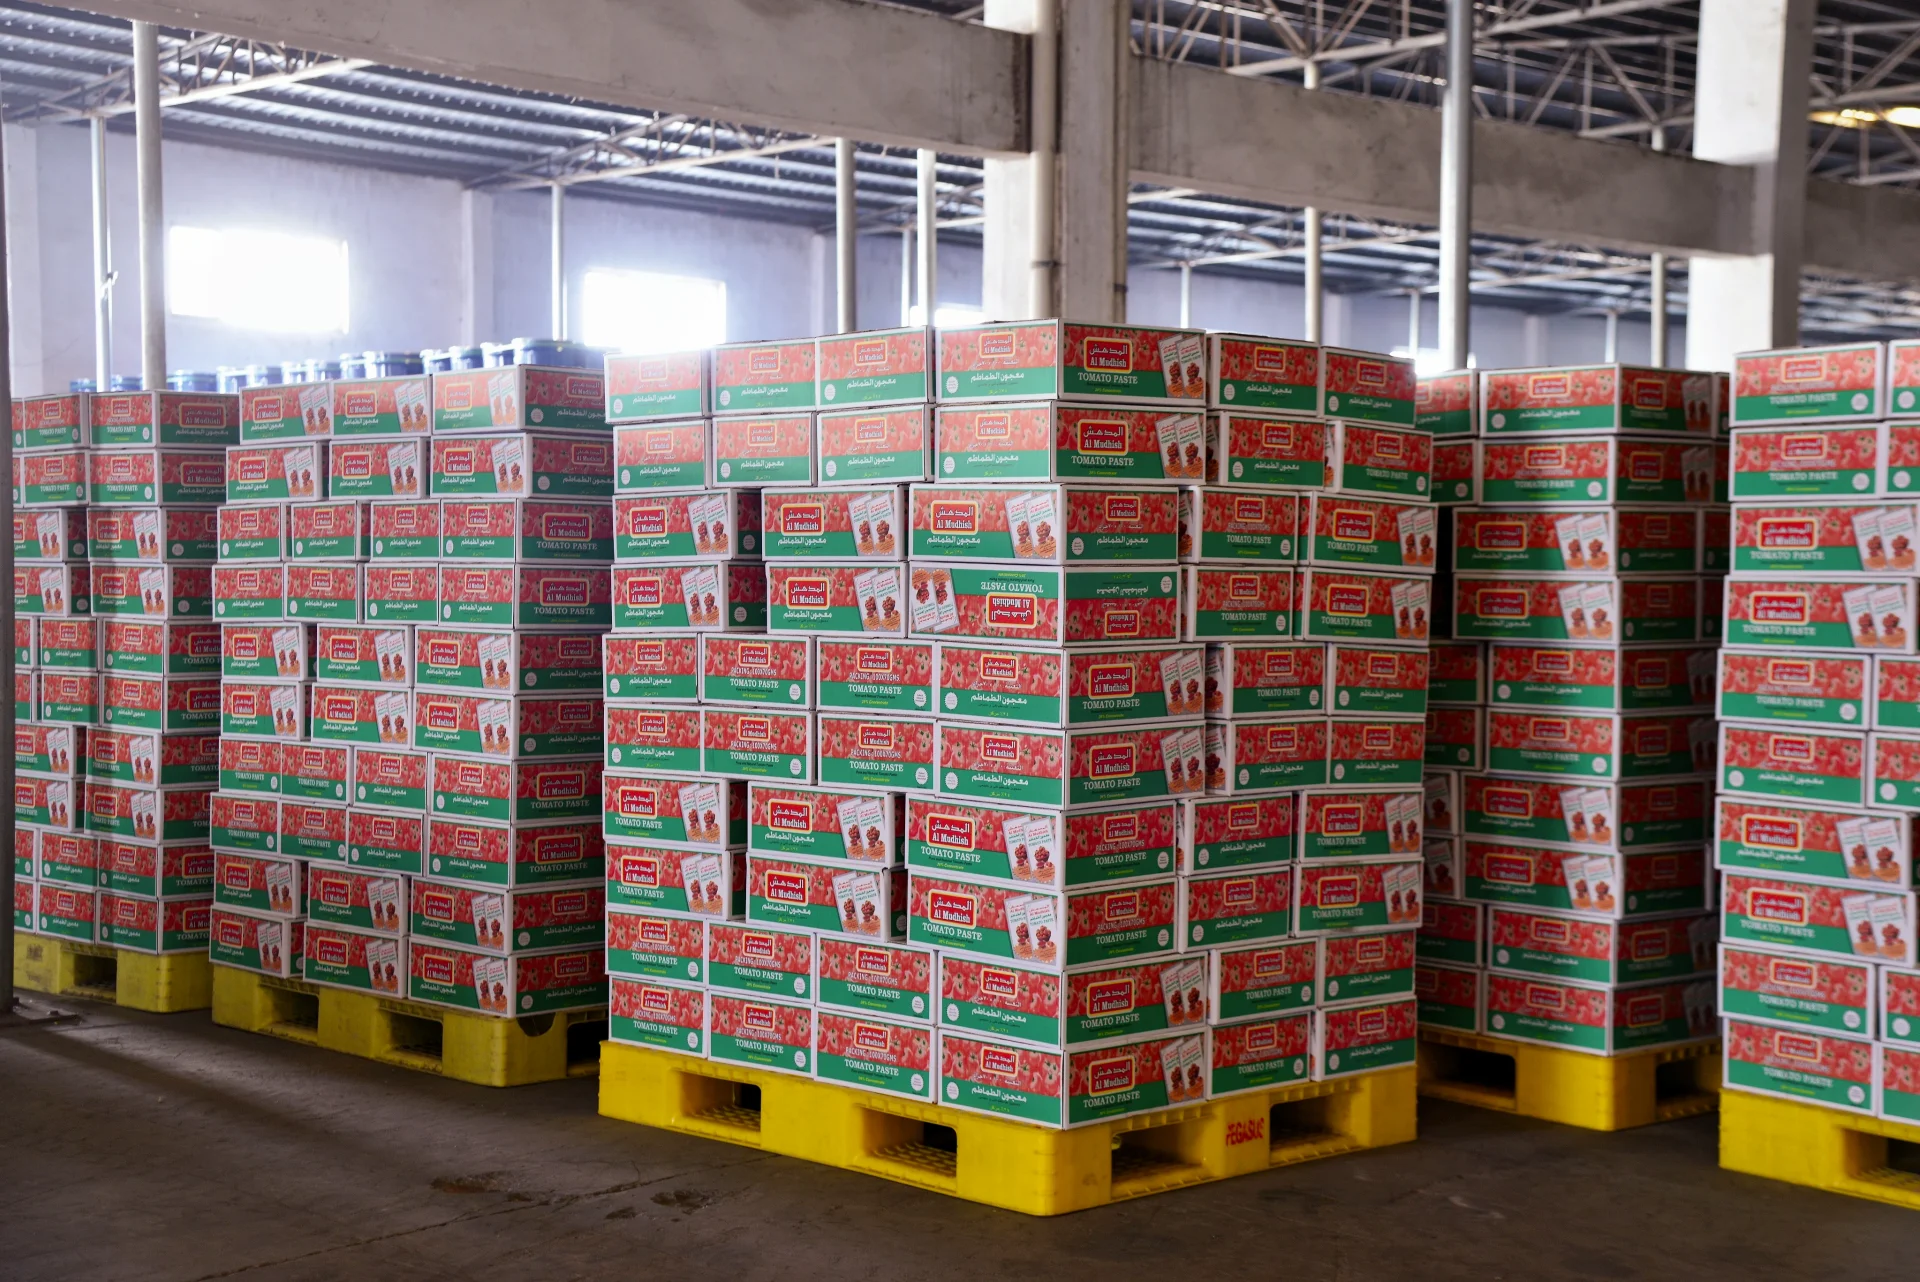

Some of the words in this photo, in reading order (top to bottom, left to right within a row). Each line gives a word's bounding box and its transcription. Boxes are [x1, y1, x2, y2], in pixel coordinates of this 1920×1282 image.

[1090, 357, 1097, 365] Al
[1099, 358, 1126, 367] Mudhish
[1078, 372, 1112, 382] TOMATO
[1114, 375, 1138, 384] PASTE
[1084, 440, 1092, 448] Al
[1094, 440, 1122, 449] Mudhish
[1071, 456, 1106, 464] TOMATO
[1109, 457, 1134, 466] PASTE
[786, 522, 792, 530] Al
[794, 522, 819, 531] Mudhish
[936, 520, 943, 528] Al
[945, 520, 972, 529] Mudhish
[558, 529, 585, 537] Mudhish
[1227, 535, 1251, 543] TOMATO
[1253, 536, 1271, 544] PASTE
[537, 541, 570, 549] TOMATO
[573, 542, 597, 550] PASTE
[981, 582, 1006, 590] PASTE
[1008, 583, 1043, 592] TOMATO
[792, 595, 797, 603] Al
[799, 595, 824, 604] Mudhish
[993, 598, 1021, 607] Mudhish
[1023, 599, 1030, 608] Al
[570, 607, 594, 615] PASTE
[992, 668, 1013, 677] Mudhish
[848, 684, 877, 693] TOMATO
[880, 686, 902, 694] PASTE
[1094, 685, 1101, 693] Al
[1103, 683, 1129, 692] Mudhish
[1083, 700, 1114, 709] TOMATO
[1117, 699, 1140, 708] PASTE
[849, 761, 878, 770] TOMATO
[881, 763, 903, 772] PASTE
[1096, 765, 1102, 773] Al
[1104, 763, 1130, 772] Mudhish
[1084, 780, 1115, 790] TOMATO
[1117, 778, 1140, 787] PASTE
[552, 787, 579, 795] Mudhish
[531, 801, 563, 809] TOMATO
[624, 804, 629, 812] Al
[630, 804, 652, 814] Mudhish
[615, 817, 640, 827] TOMATO
[643, 819, 662, 829] PASTE
[774, 817, 780, 826] Al
[781, 818, 806, 828] Mudhish
[1114, 829, 1133, 837] Mudhish
[932, 832, 939, 841] Al
[941, 833, 968, 845] Mudhish
[921, 846, 953, 858] TOMATO
[956, 850, 981, 862] PASTE
[1095, 855, 1123, 865] TOMATO
[1126, 852, 1146, 861] PASTE
[771, 889, 776, 897] Al
[778, 890, 803, 900] Mudhish
[934, 910, 941, 918] Al
[943, 910, 970, 923] Mudhish
[922, 923, 955, 935] TOMATO
[957, 928, 982, 940] PASTE
[992, 984, 1013, 993] Mudhish
[1093, 1003, 1100, 1012] Al
[1102, 998, 1128, 1010] Mudhish
[1081, 1018, 1113, 1029] TOMATO
[1116, 1013, 1139, 1024] PASTE
[865, 1038, 885, 1047] Mudhish
[844, 1059, 874, 1071] TOMATO
[876, 1065, 899, 1076] PASTE
[1095, 1080, 1102, 1089] Al
[1104, 1077, 1129, 1088] Mudhish
[1083, 1095, 1115, 1108] TOMATO
[1118, 1091, 1140, 1101] PASTE
